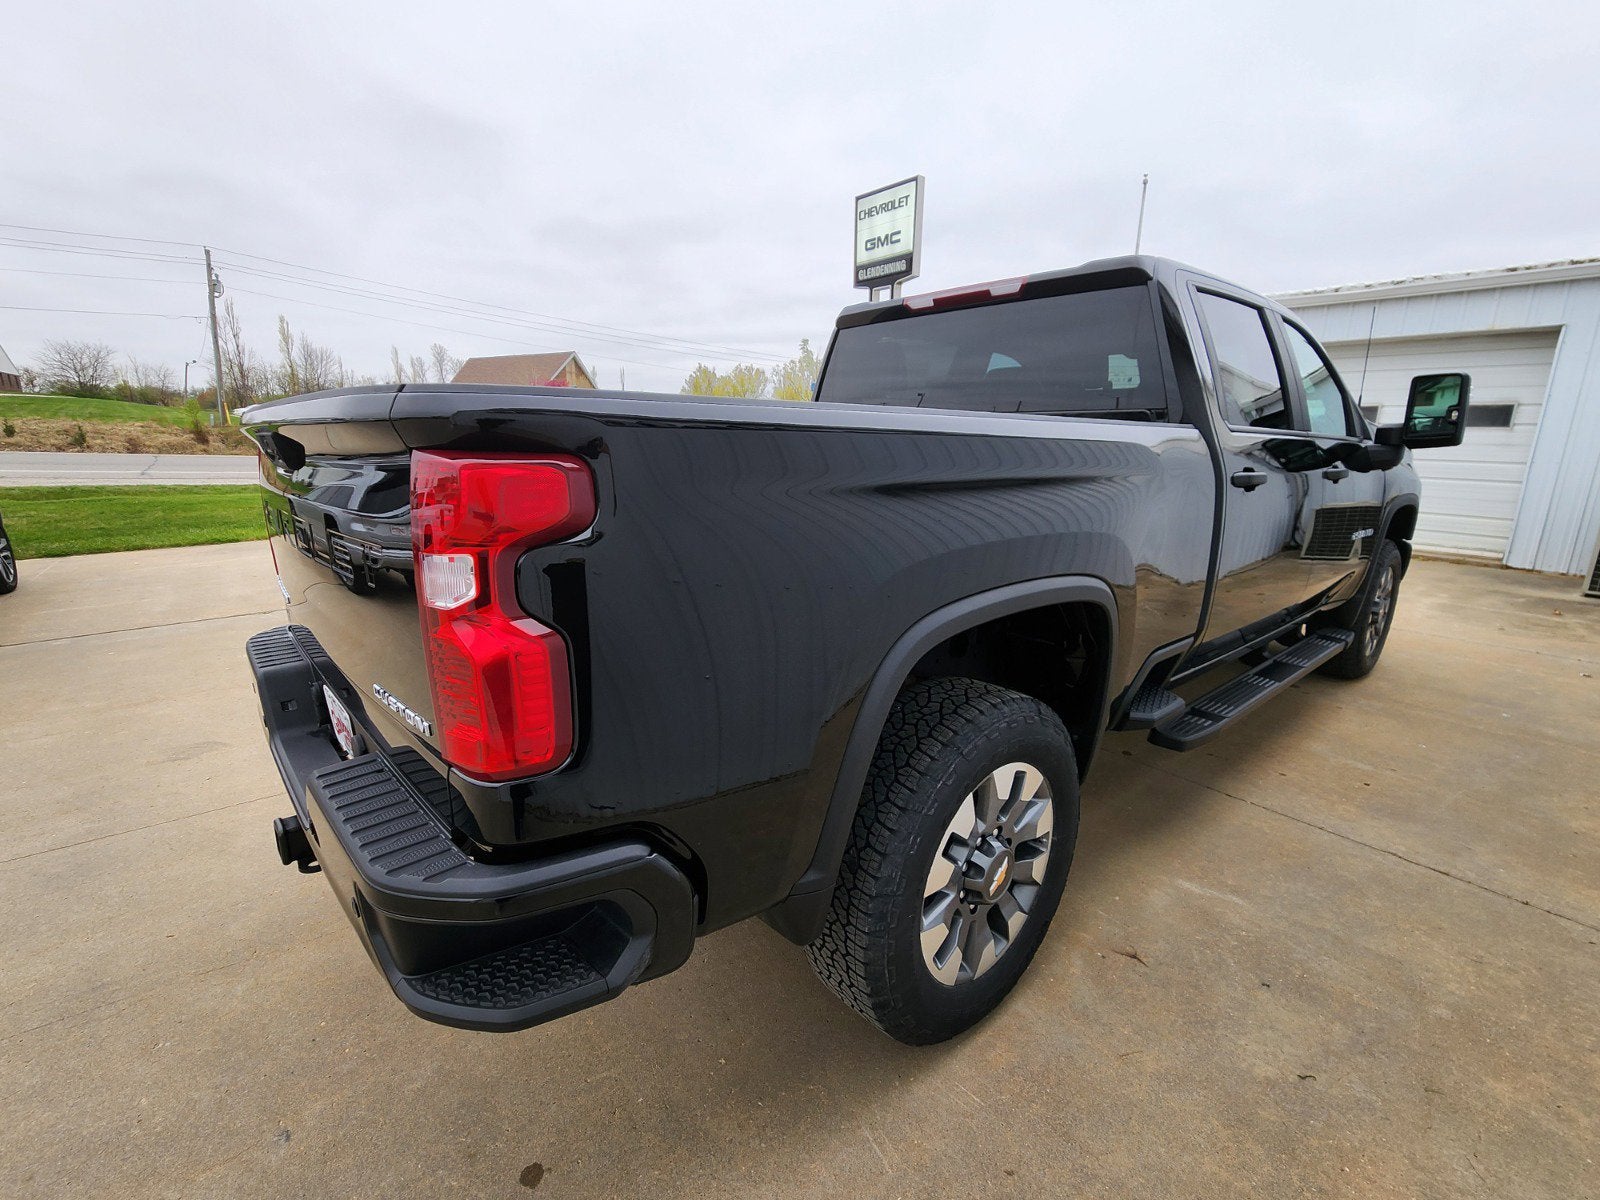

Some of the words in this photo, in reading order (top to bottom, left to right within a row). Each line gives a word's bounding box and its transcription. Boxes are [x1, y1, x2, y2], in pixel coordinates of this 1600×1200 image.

[859, 195, 910, 220] CHEVROLET
[865, 231, 901, 251] GMC
[859, 260, 906, 280] GLENDENNING
[373, 683, 432, 737] CUSTOM
